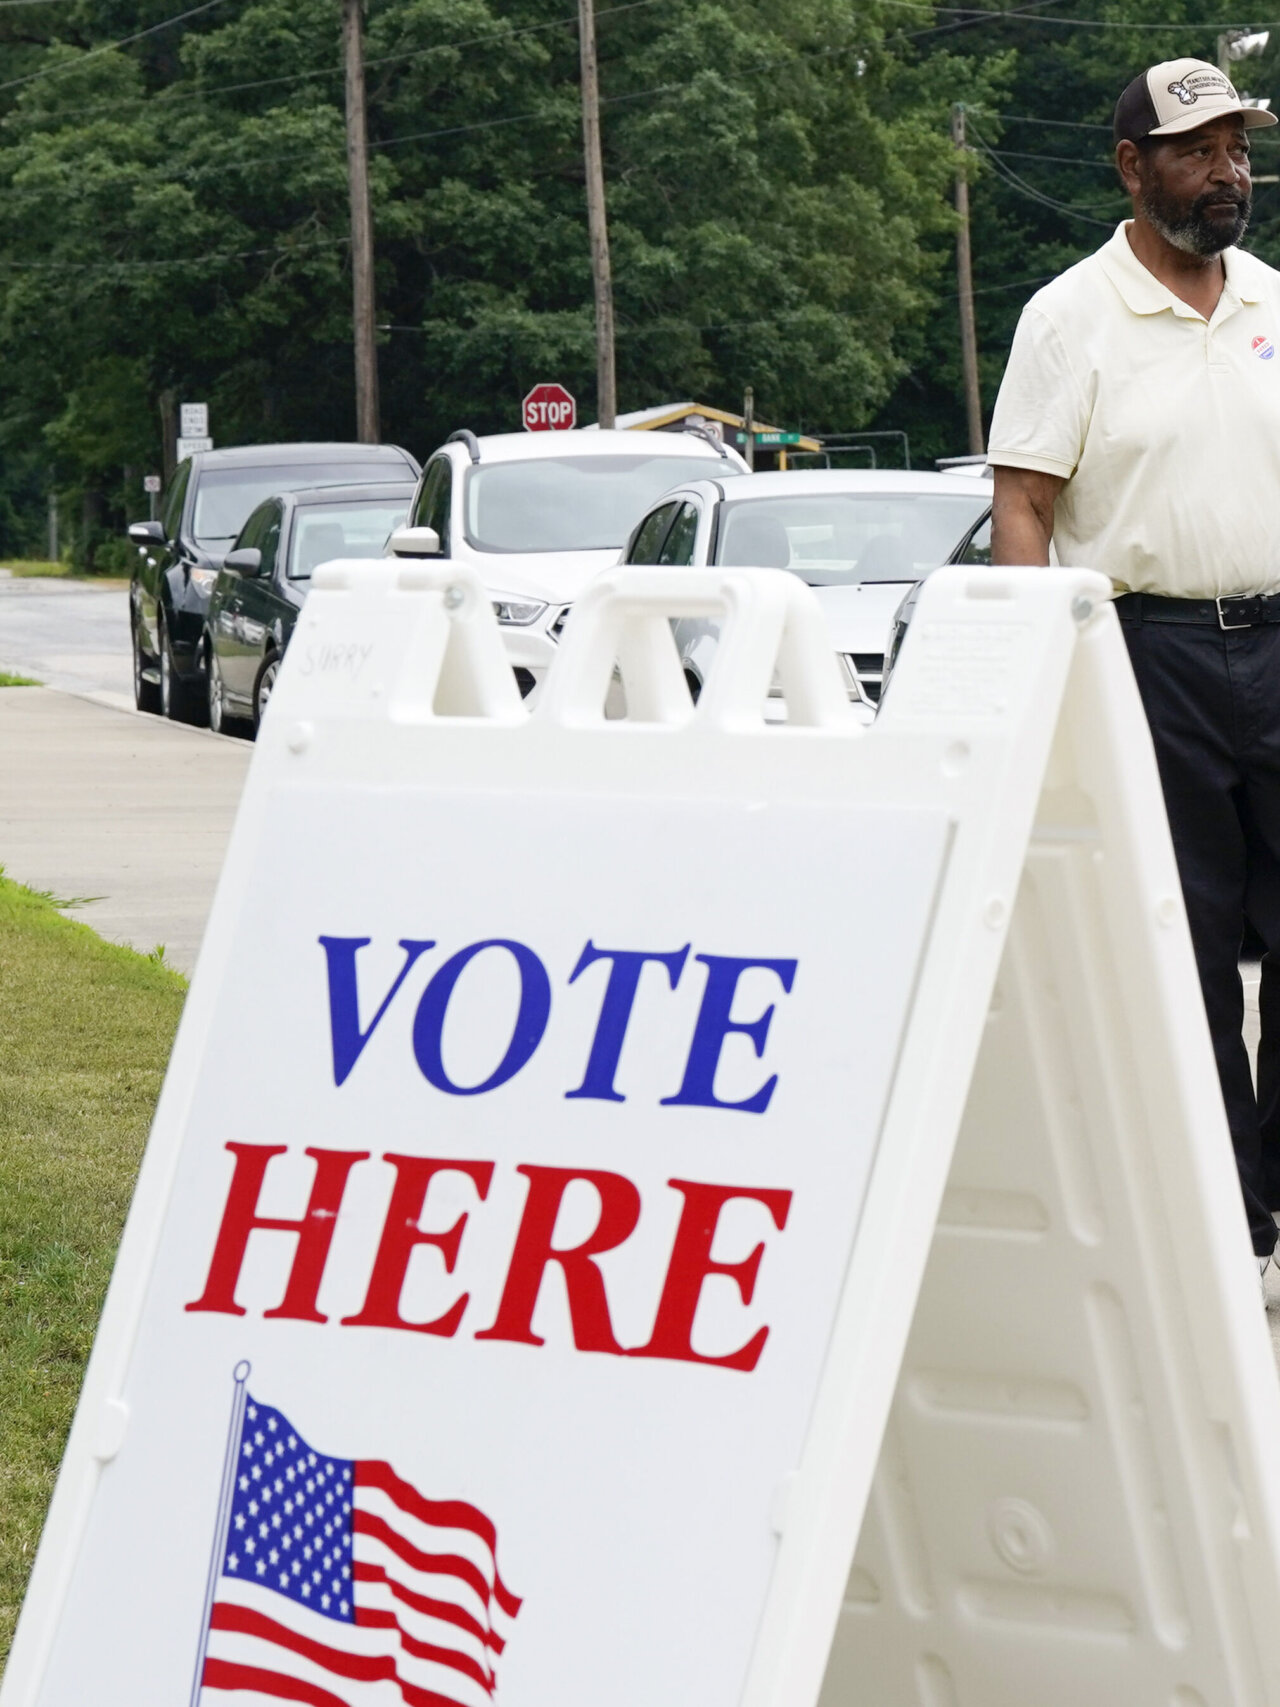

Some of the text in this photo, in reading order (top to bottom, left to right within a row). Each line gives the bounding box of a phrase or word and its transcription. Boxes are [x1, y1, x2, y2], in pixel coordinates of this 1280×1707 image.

[527, 401, 572, 424] STOP
[761, 433, 781, 443] BANK
[318, 935, 799, 1114] VOTE
[184, 1140, 794, 1372] HERE
